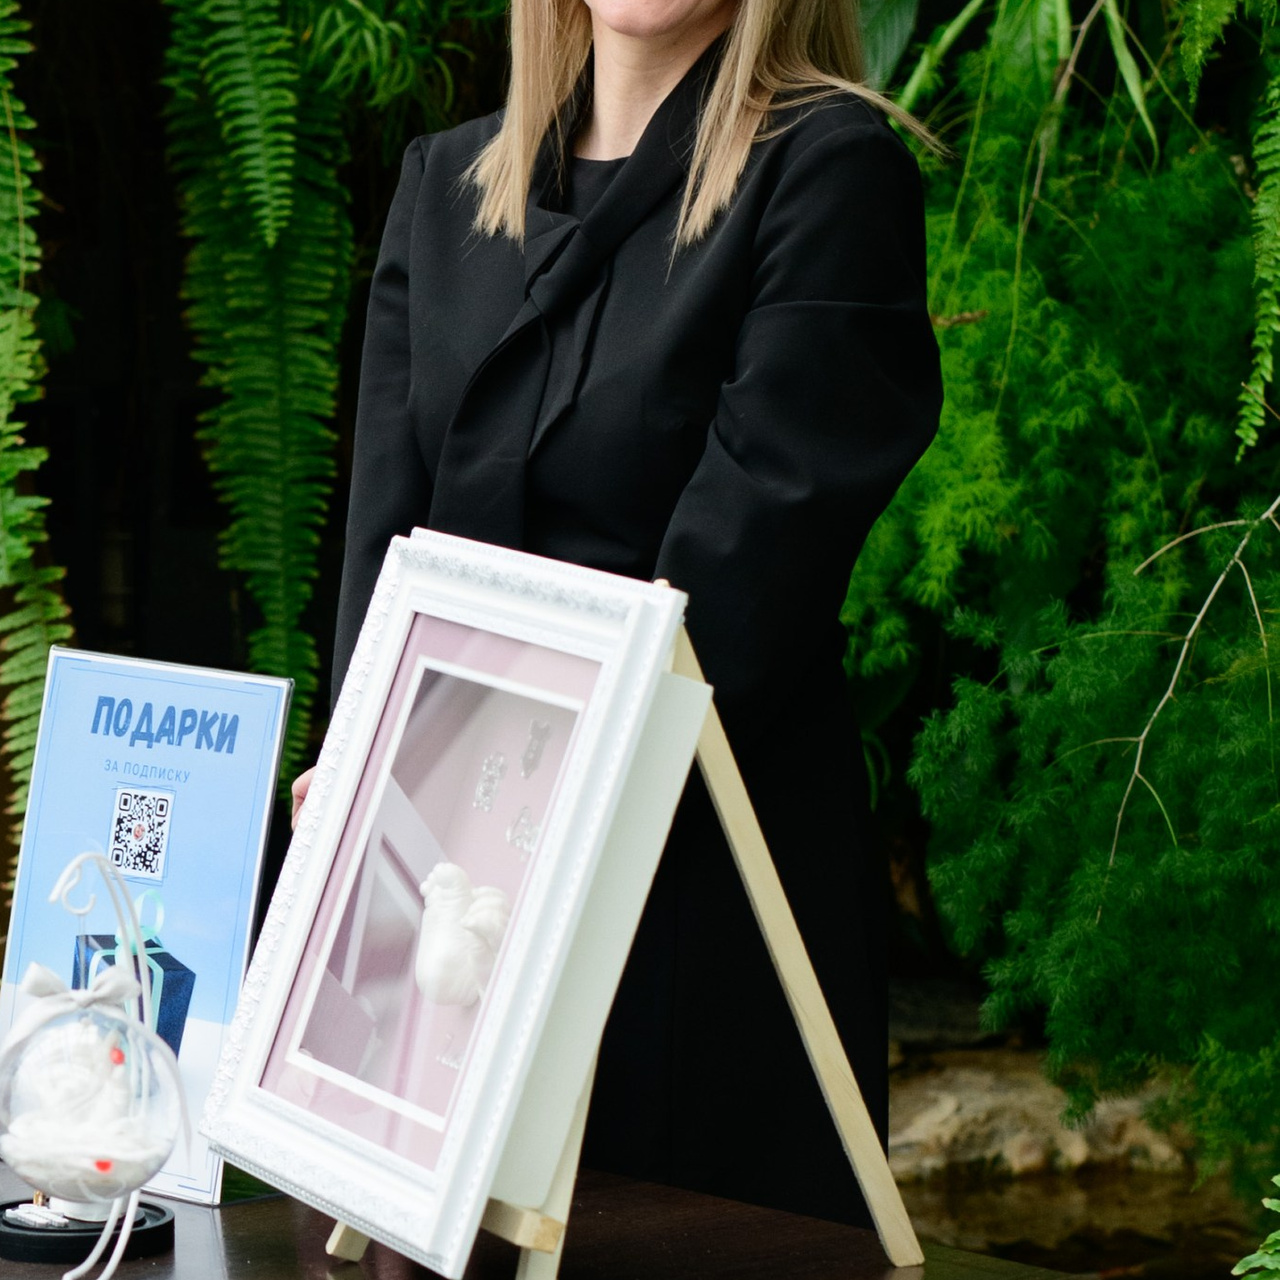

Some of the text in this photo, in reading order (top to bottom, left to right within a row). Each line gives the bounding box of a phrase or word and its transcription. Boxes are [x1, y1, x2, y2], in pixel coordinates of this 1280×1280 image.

[91, 696, 239, 754] ПОДАРКИ
[104, 759, 190, 783] ЗА ПОДПИСКУ
